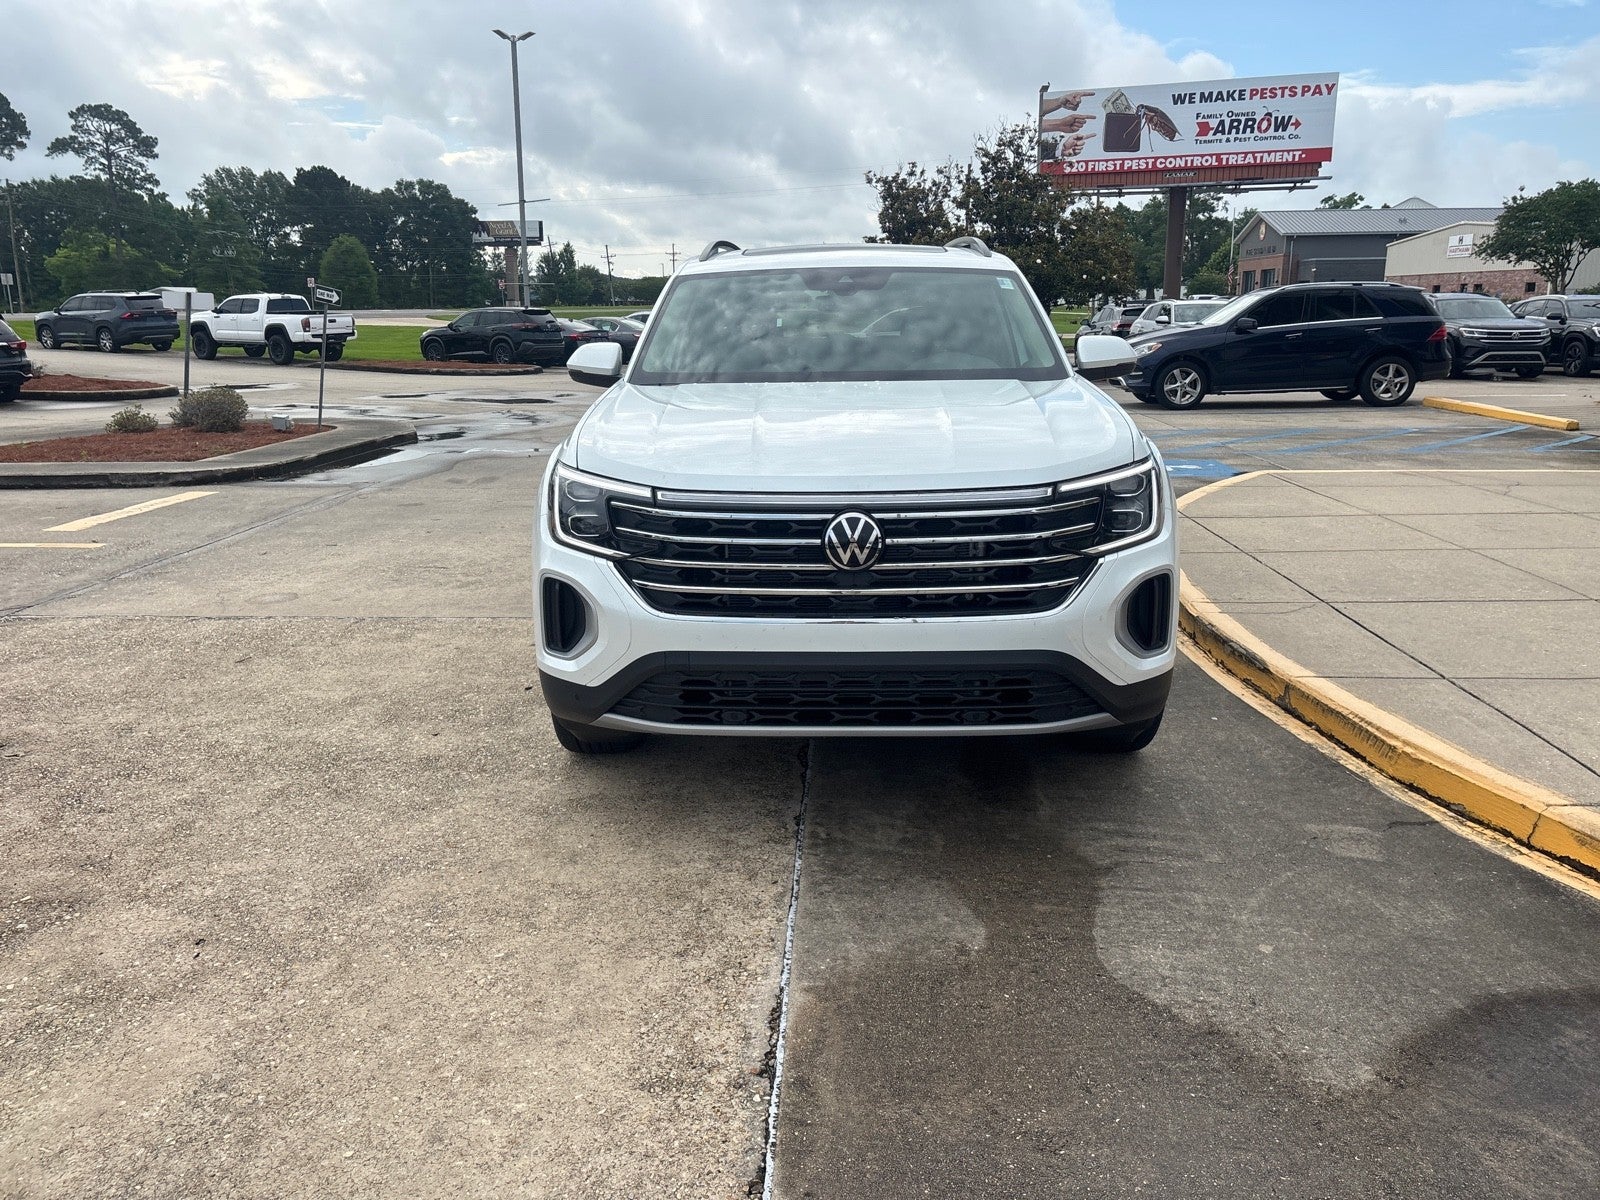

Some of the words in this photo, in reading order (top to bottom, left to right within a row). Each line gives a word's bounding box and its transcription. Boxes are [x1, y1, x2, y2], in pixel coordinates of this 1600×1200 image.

[1171, 92, 1196, 106] WE
[1199, 89, 1247, 104] MAKE
[1249, 85, 1298, 100] PESTS
[1301, 83, 1337, 97] PAY
[1195, 112, 1223, 120] FAMILY
[1226, 110, 1257, 118] OWNED
[1212, 115, 1292, 136] ARROW
[1194, 137, 1223, 145] TERMITE
[1234, 135, 1252, 143] PEST
[1253, 133, 1286, 142] CONTROL
[1063, 161, 1086, 174] $20
[1088, 159, 1122, 172] FIRST
[1124, 158, 1155, 170] PEST
[1156, 154, 1219, 169] CONTROL
